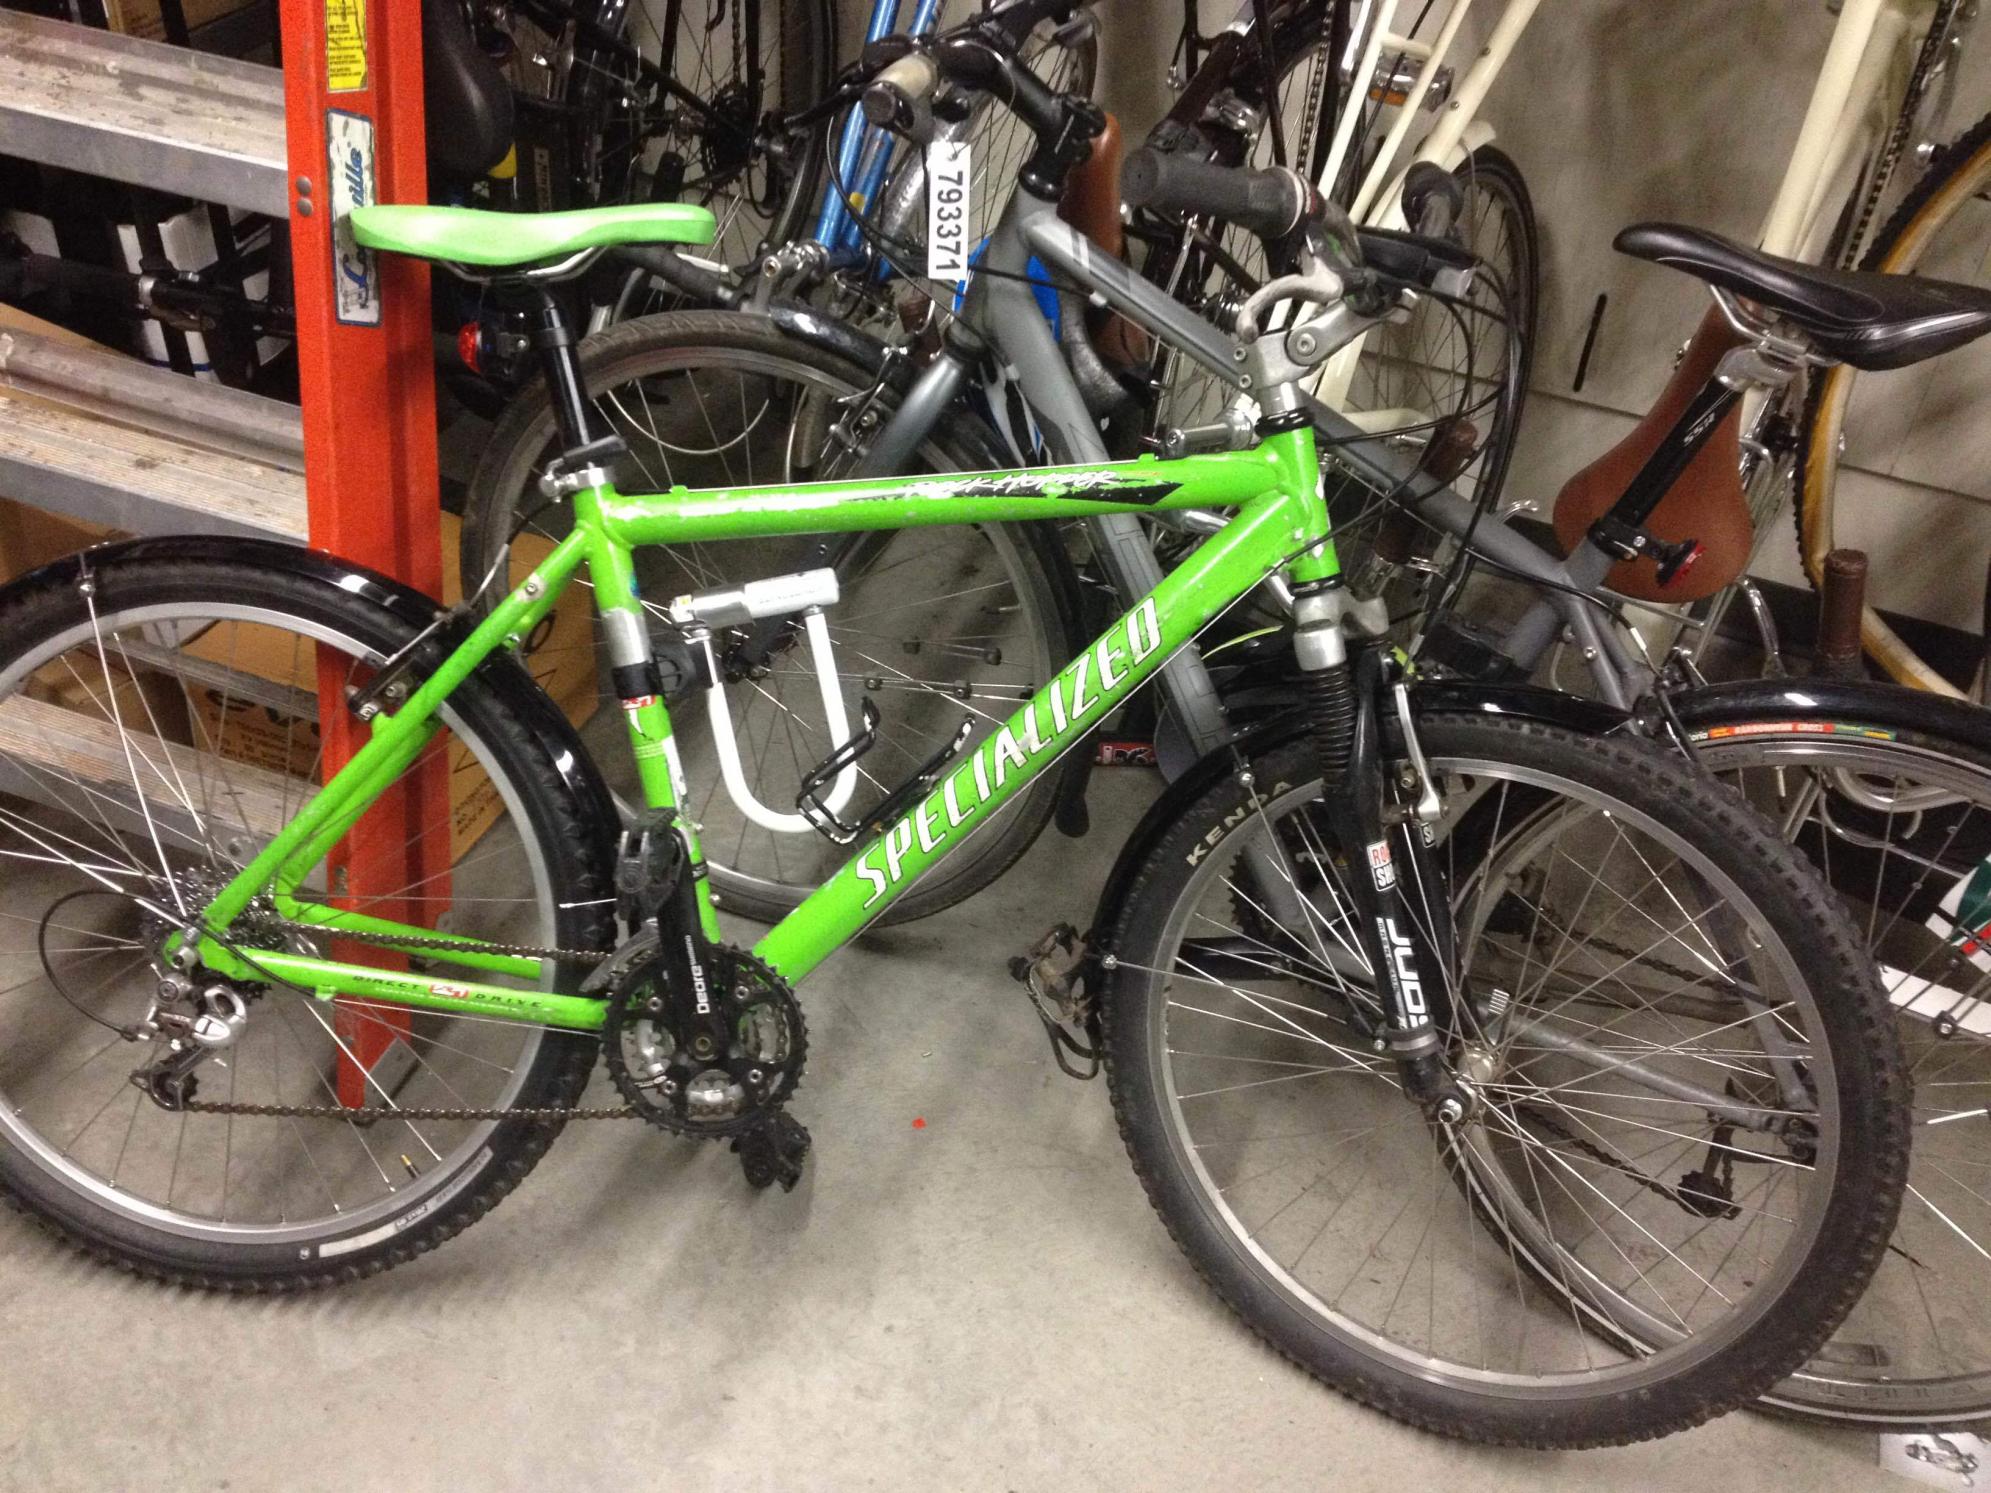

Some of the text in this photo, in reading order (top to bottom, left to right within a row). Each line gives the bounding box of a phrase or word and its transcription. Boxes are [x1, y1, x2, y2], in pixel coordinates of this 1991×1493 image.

[936, 170, 963, 270] 793371
[856, 597, 1162, 910] SPECIALIZED
[1186, 781, 1293, 867] KENDA
